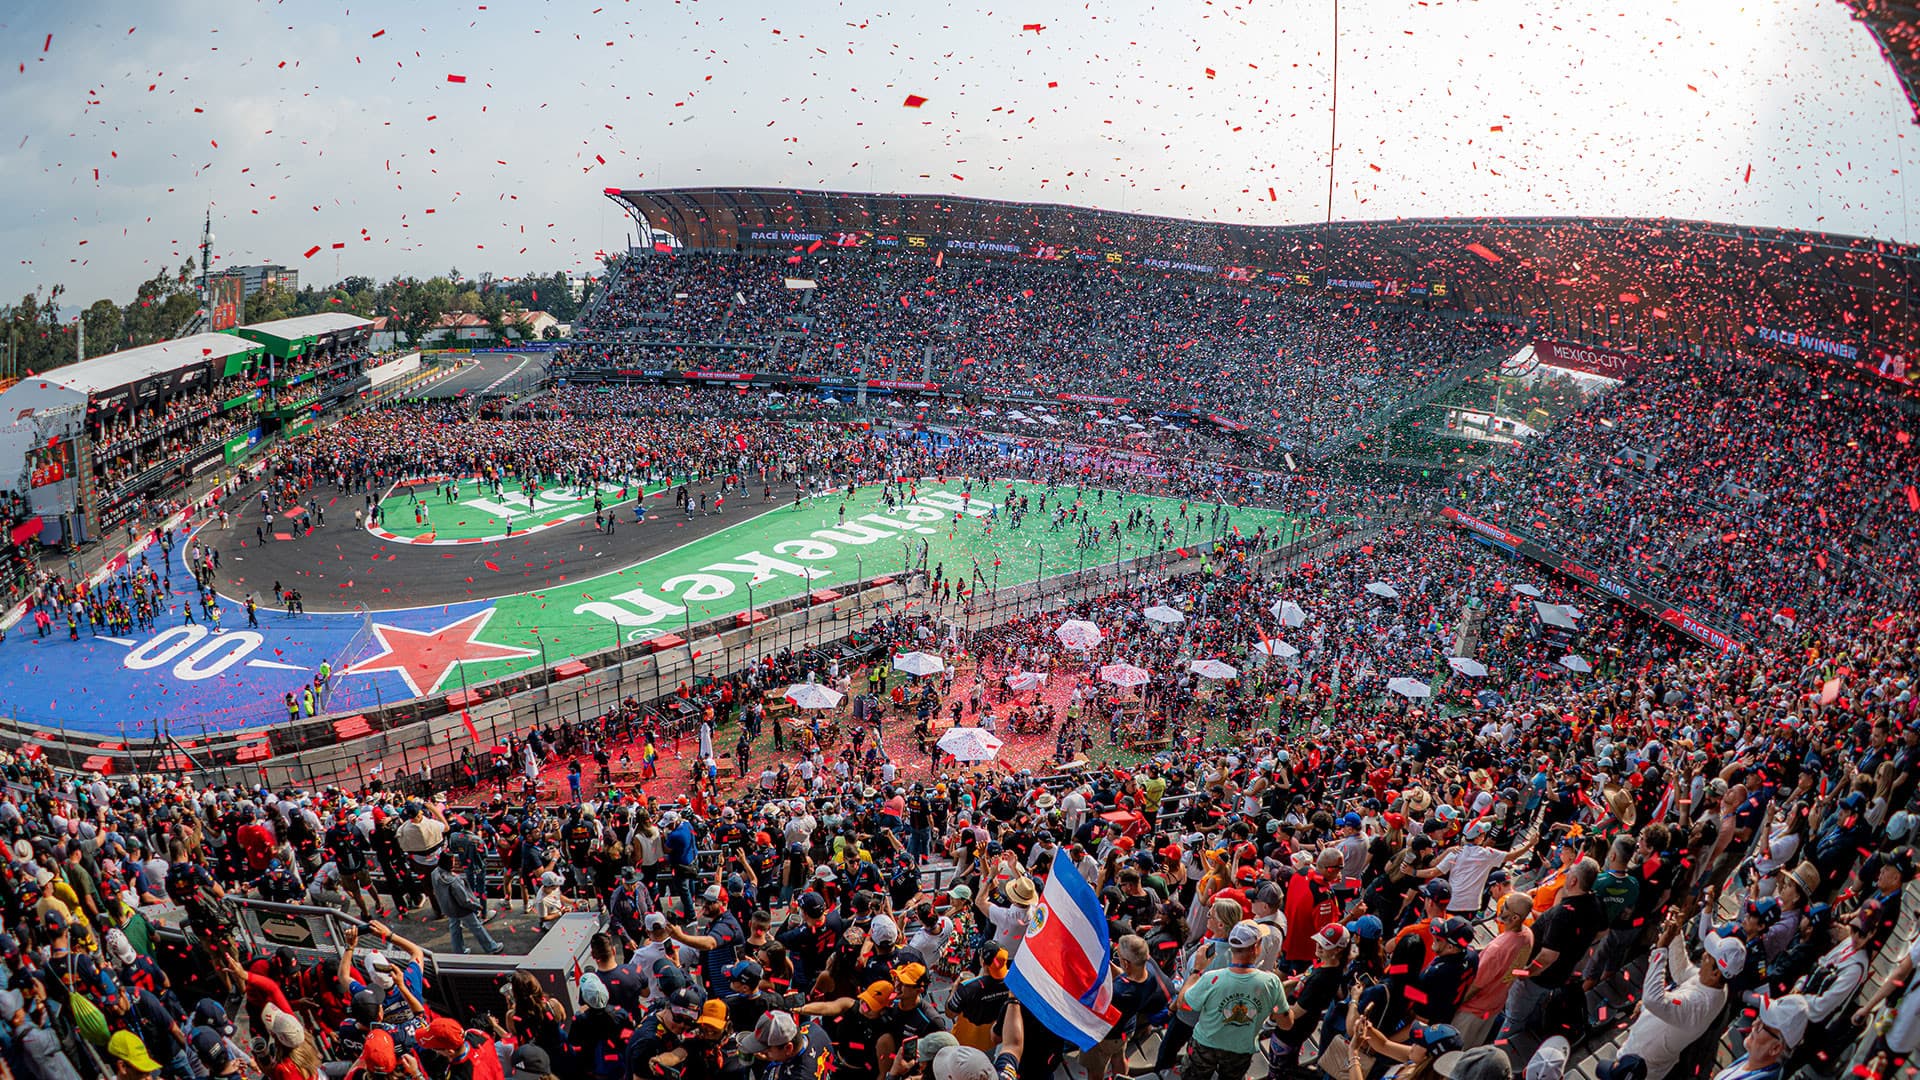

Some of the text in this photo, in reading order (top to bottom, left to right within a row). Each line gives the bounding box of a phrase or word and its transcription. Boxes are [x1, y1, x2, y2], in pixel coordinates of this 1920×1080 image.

[751, 231, 823, 242] RACE WINNER
[908, 236, 926, 248] 55
[947, 240, 1020, 253] RACE WINNER
[1105, 252, 1123, 264] 55
[1172, 260, 1214, 274] WINNER
[1433, 284, 1447, 296] 55
[1759, 327, 1858, 360] RACE WINNER
[1553, 345, 1627, 370] MEXICO CITY
[1457, 513, 1506, 541] RACE WINNER
[1561, 559, 1631, 600] CARLOS SAINZ
[1682, 618, 1710, 640] RACE
